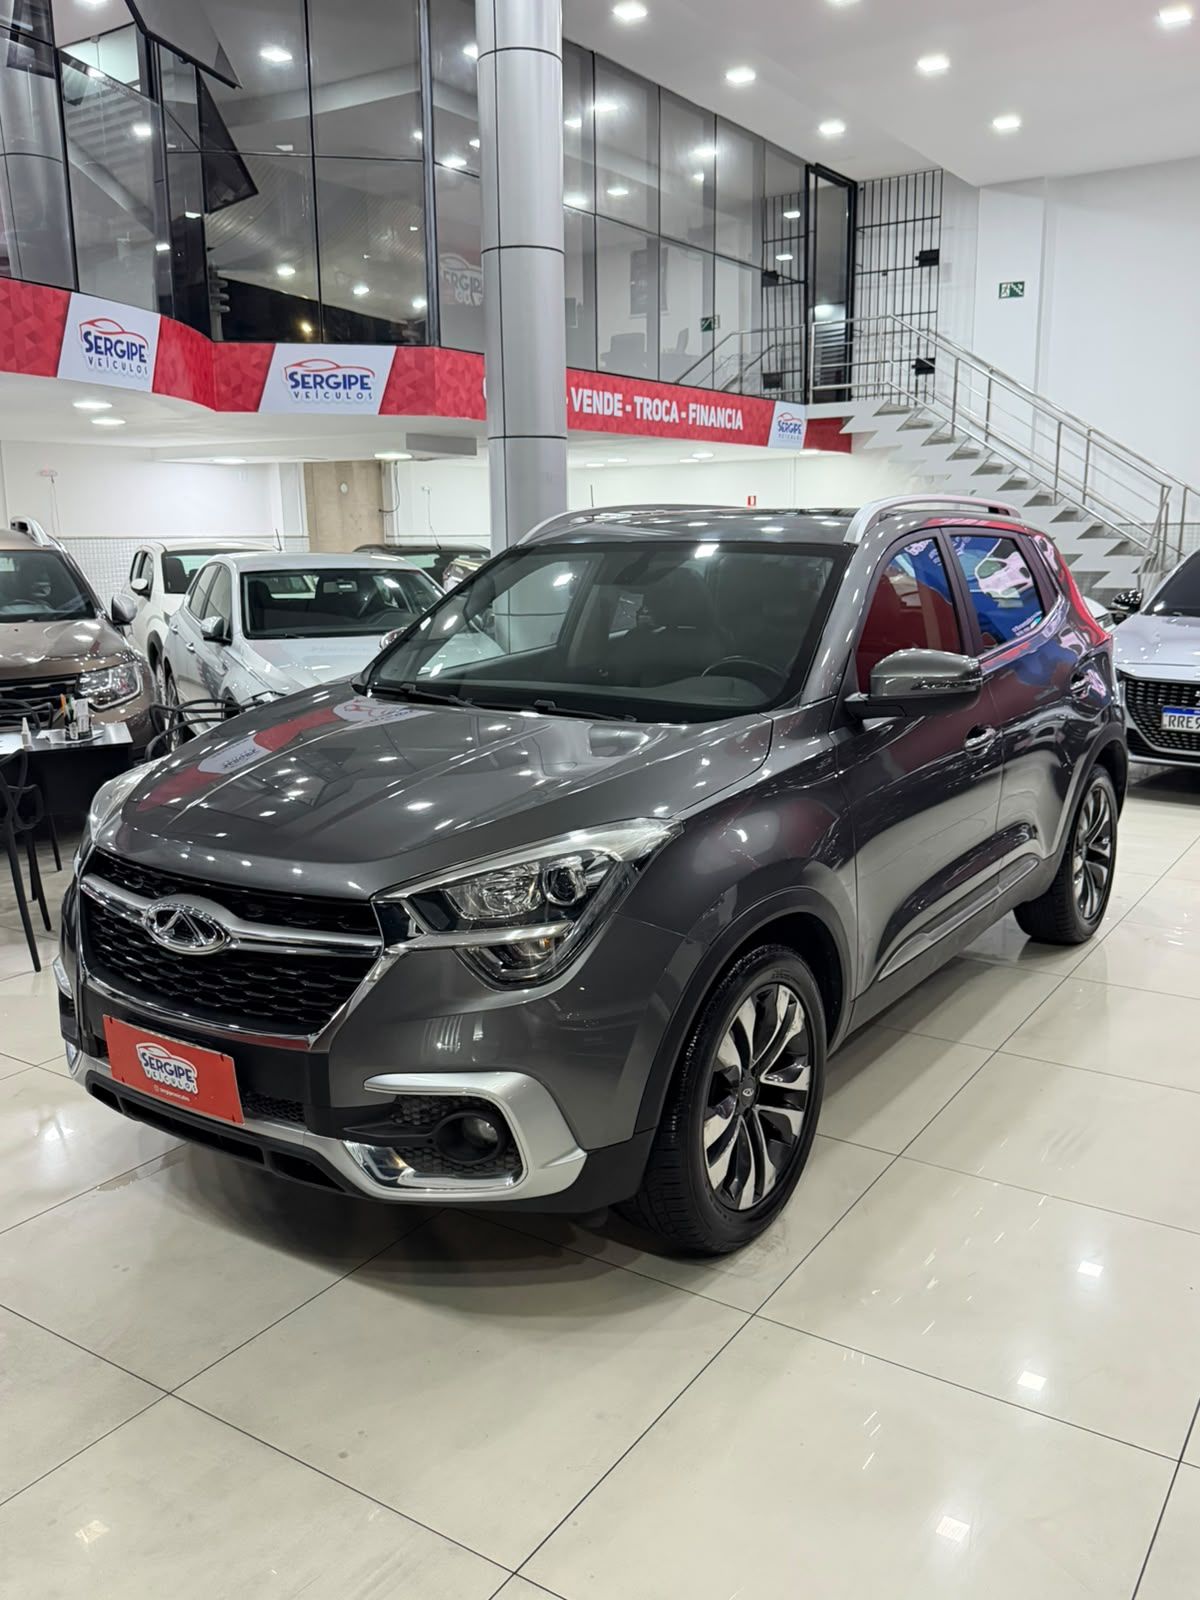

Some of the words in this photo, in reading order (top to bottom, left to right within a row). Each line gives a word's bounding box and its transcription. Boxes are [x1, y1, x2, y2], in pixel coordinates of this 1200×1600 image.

[443, 270, 482, 294] ERGIP
[83, 330, 147, 364] SERGIPE
[288, 371, 372, 390] SERGIPE
[570, 387, 623, 417] VENDE
[633, 395, 679, 423] TROCA
[688, 403, 744, 430] FINANCIA
[141, 1053, 194, 1083] SERGIPE
